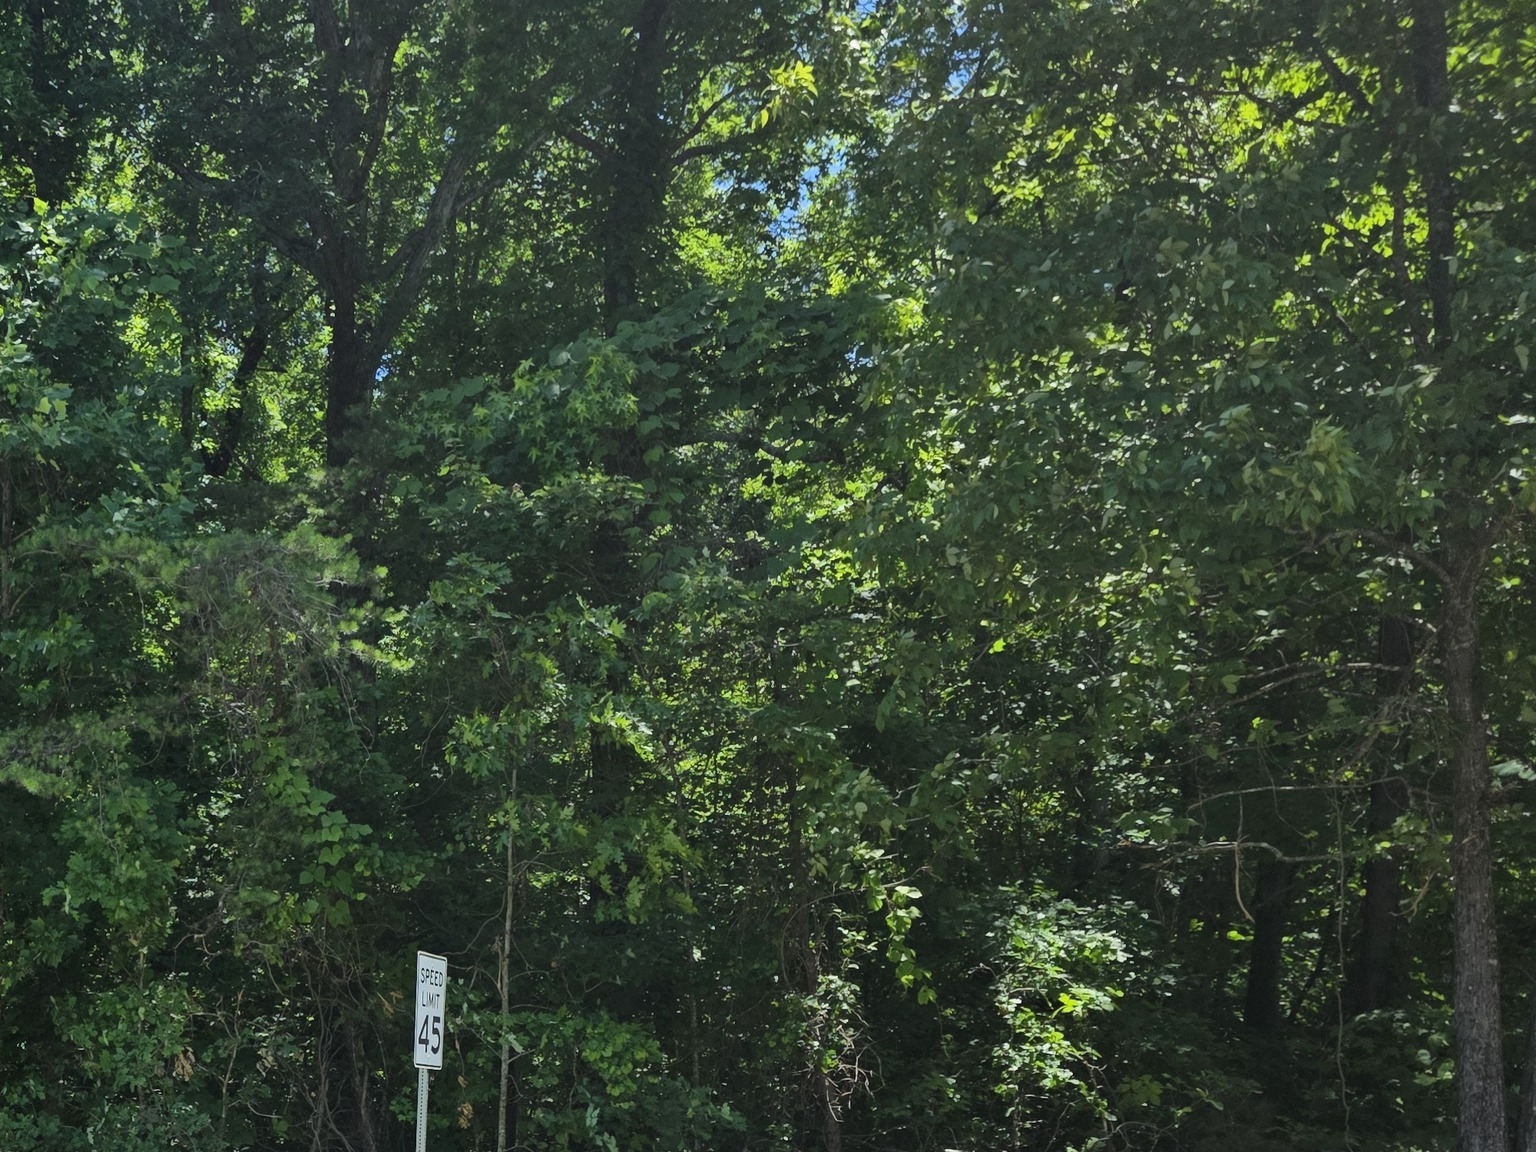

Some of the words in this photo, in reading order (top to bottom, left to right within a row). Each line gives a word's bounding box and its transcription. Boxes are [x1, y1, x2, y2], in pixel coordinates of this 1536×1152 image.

[420, 968, 443, 987] SPEED
[421, 991, 440, 1010] LIMIT
[418, 1014, 441, 1055] 45
